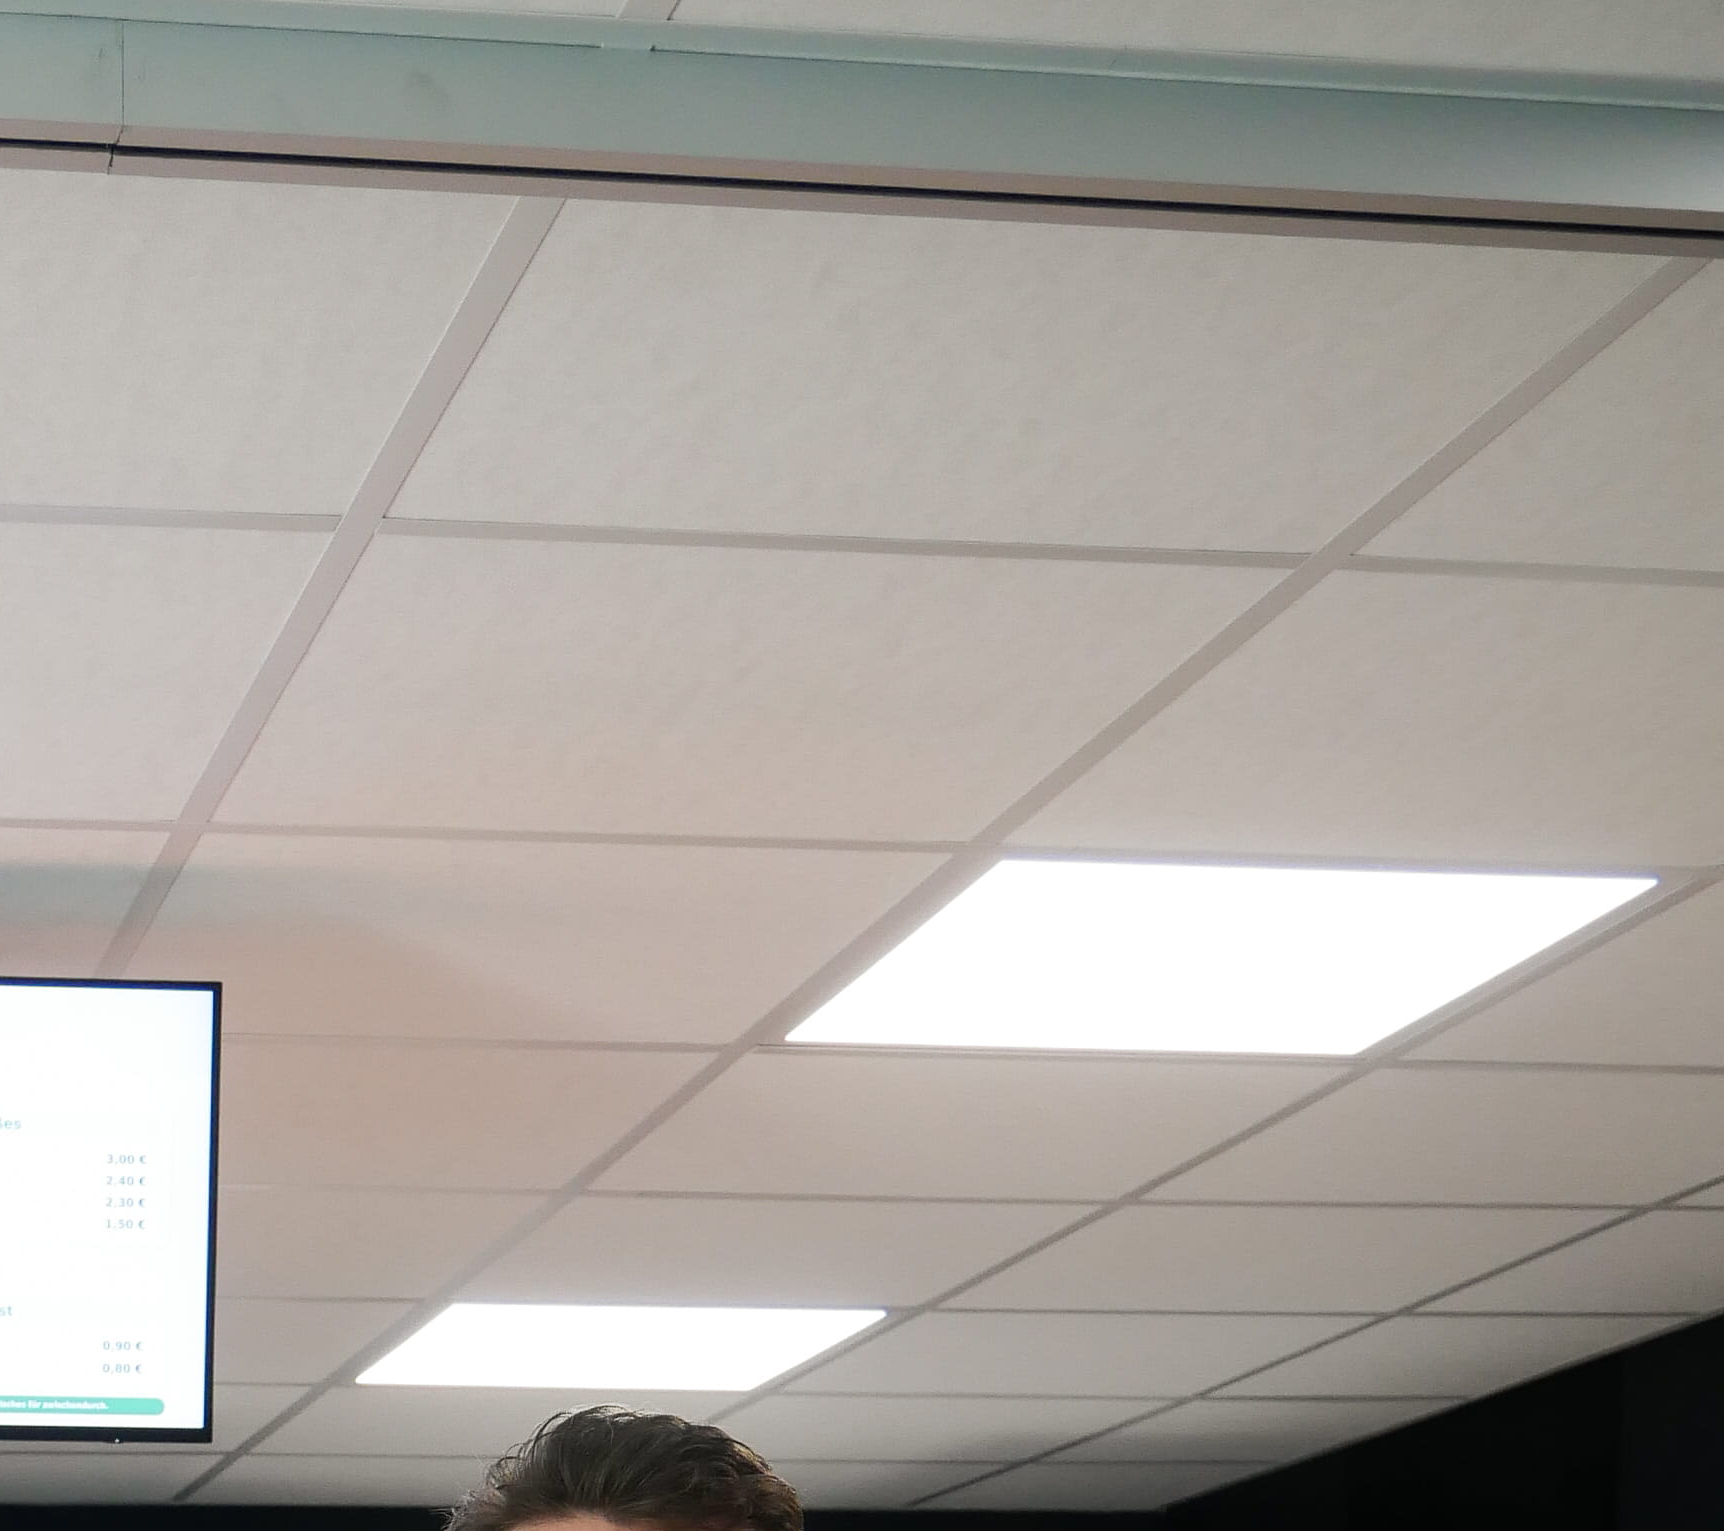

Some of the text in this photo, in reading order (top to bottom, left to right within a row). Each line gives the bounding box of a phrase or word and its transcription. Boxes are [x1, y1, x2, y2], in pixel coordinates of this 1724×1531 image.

[106, 1154, 136, 1165] 3,00
[106, 1175, 135, 1187] 2,40
[105, 1197, 134, 1209] 2,30
[105, 1219, 134, 1231] 1,50
[102, 1340, 131, 1352] 0,90
[102, 1363, 131, 1375] 0,80
